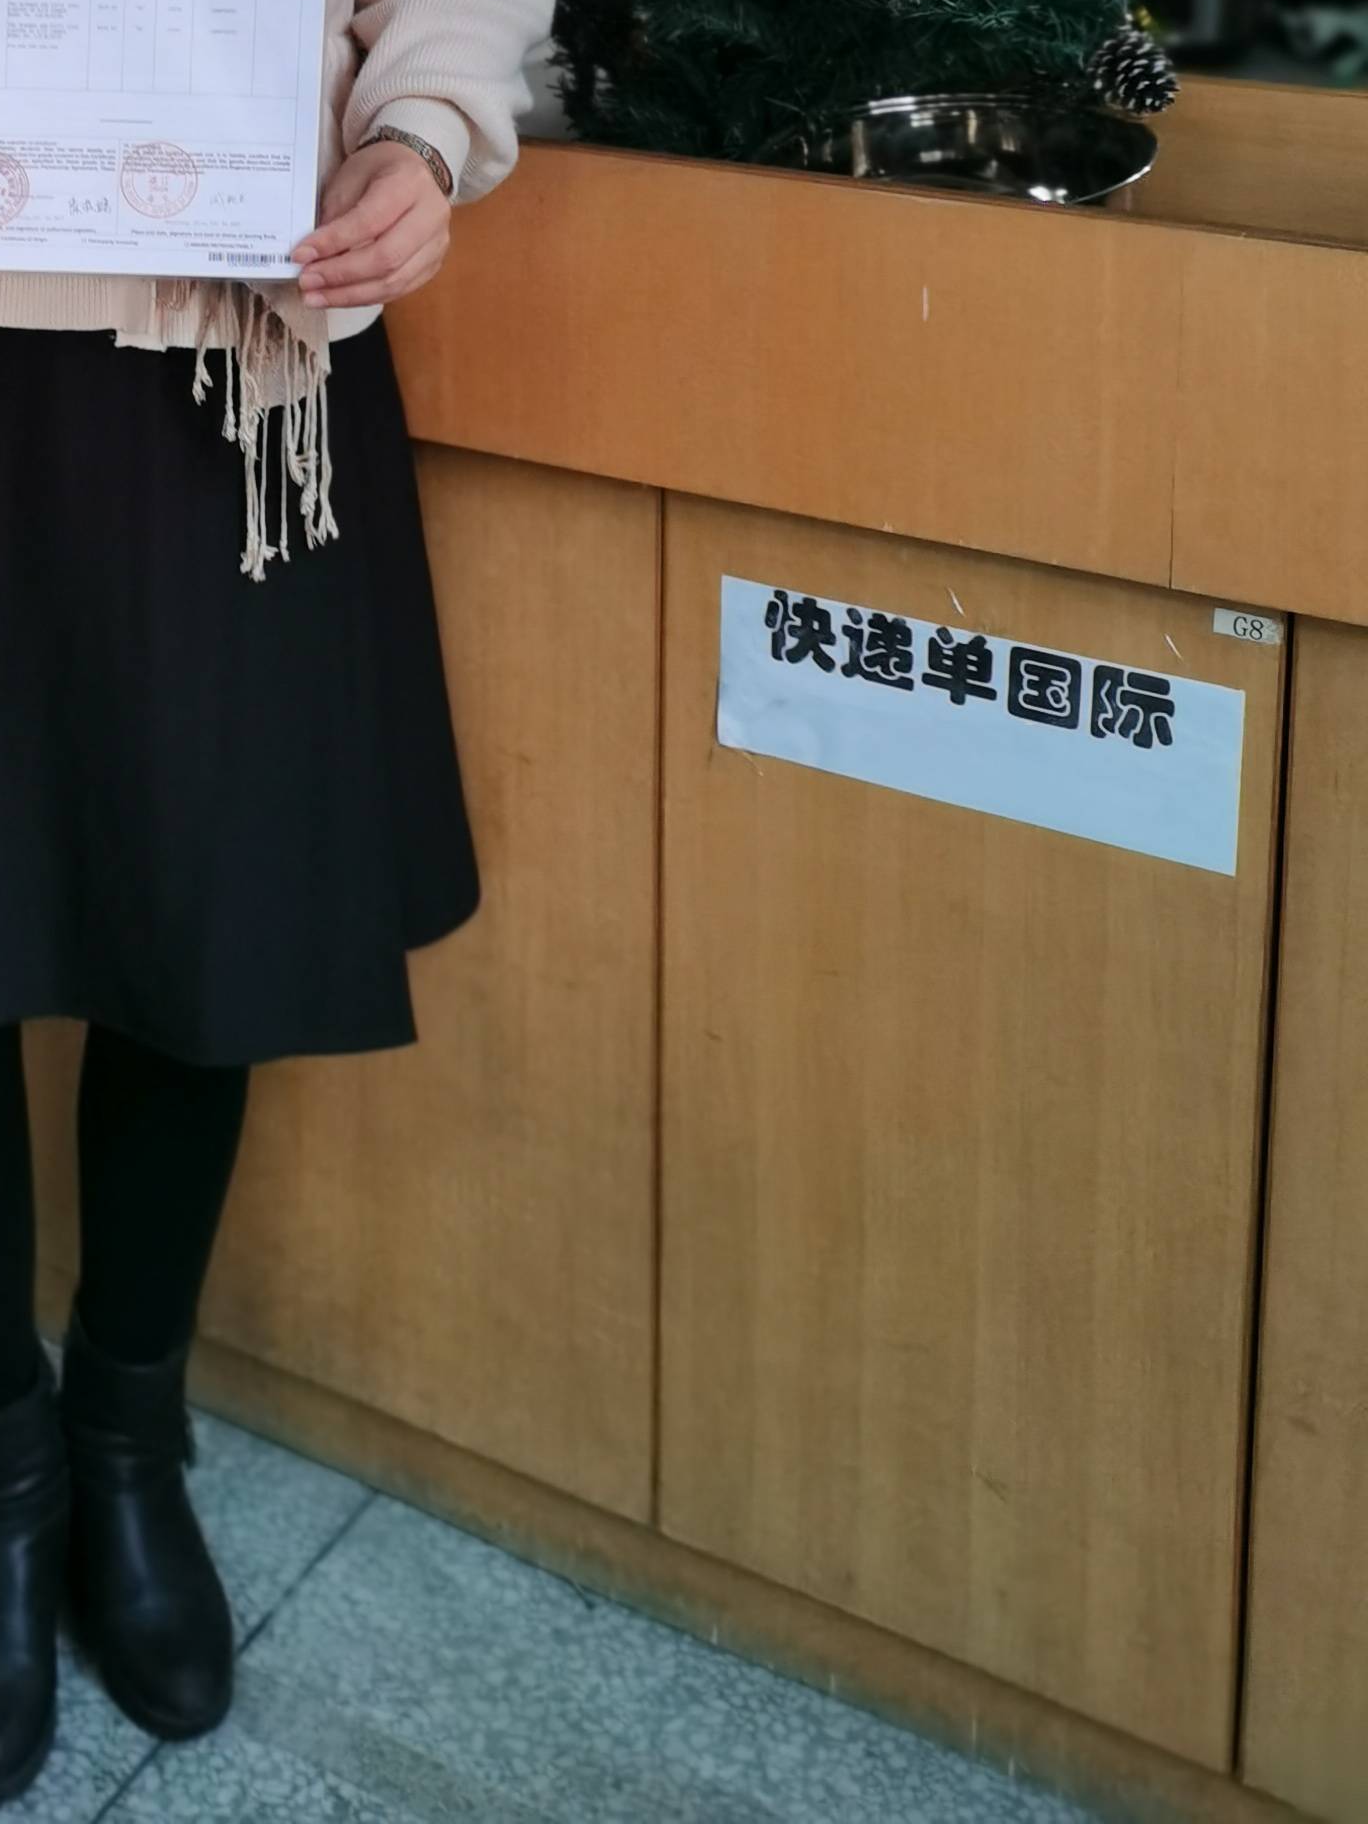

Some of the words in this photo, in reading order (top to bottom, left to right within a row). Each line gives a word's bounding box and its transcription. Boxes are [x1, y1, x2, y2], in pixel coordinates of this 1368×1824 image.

[764, 589, 1176, 750] 快递单国际
[1233, 615, 1264, 640] G8
